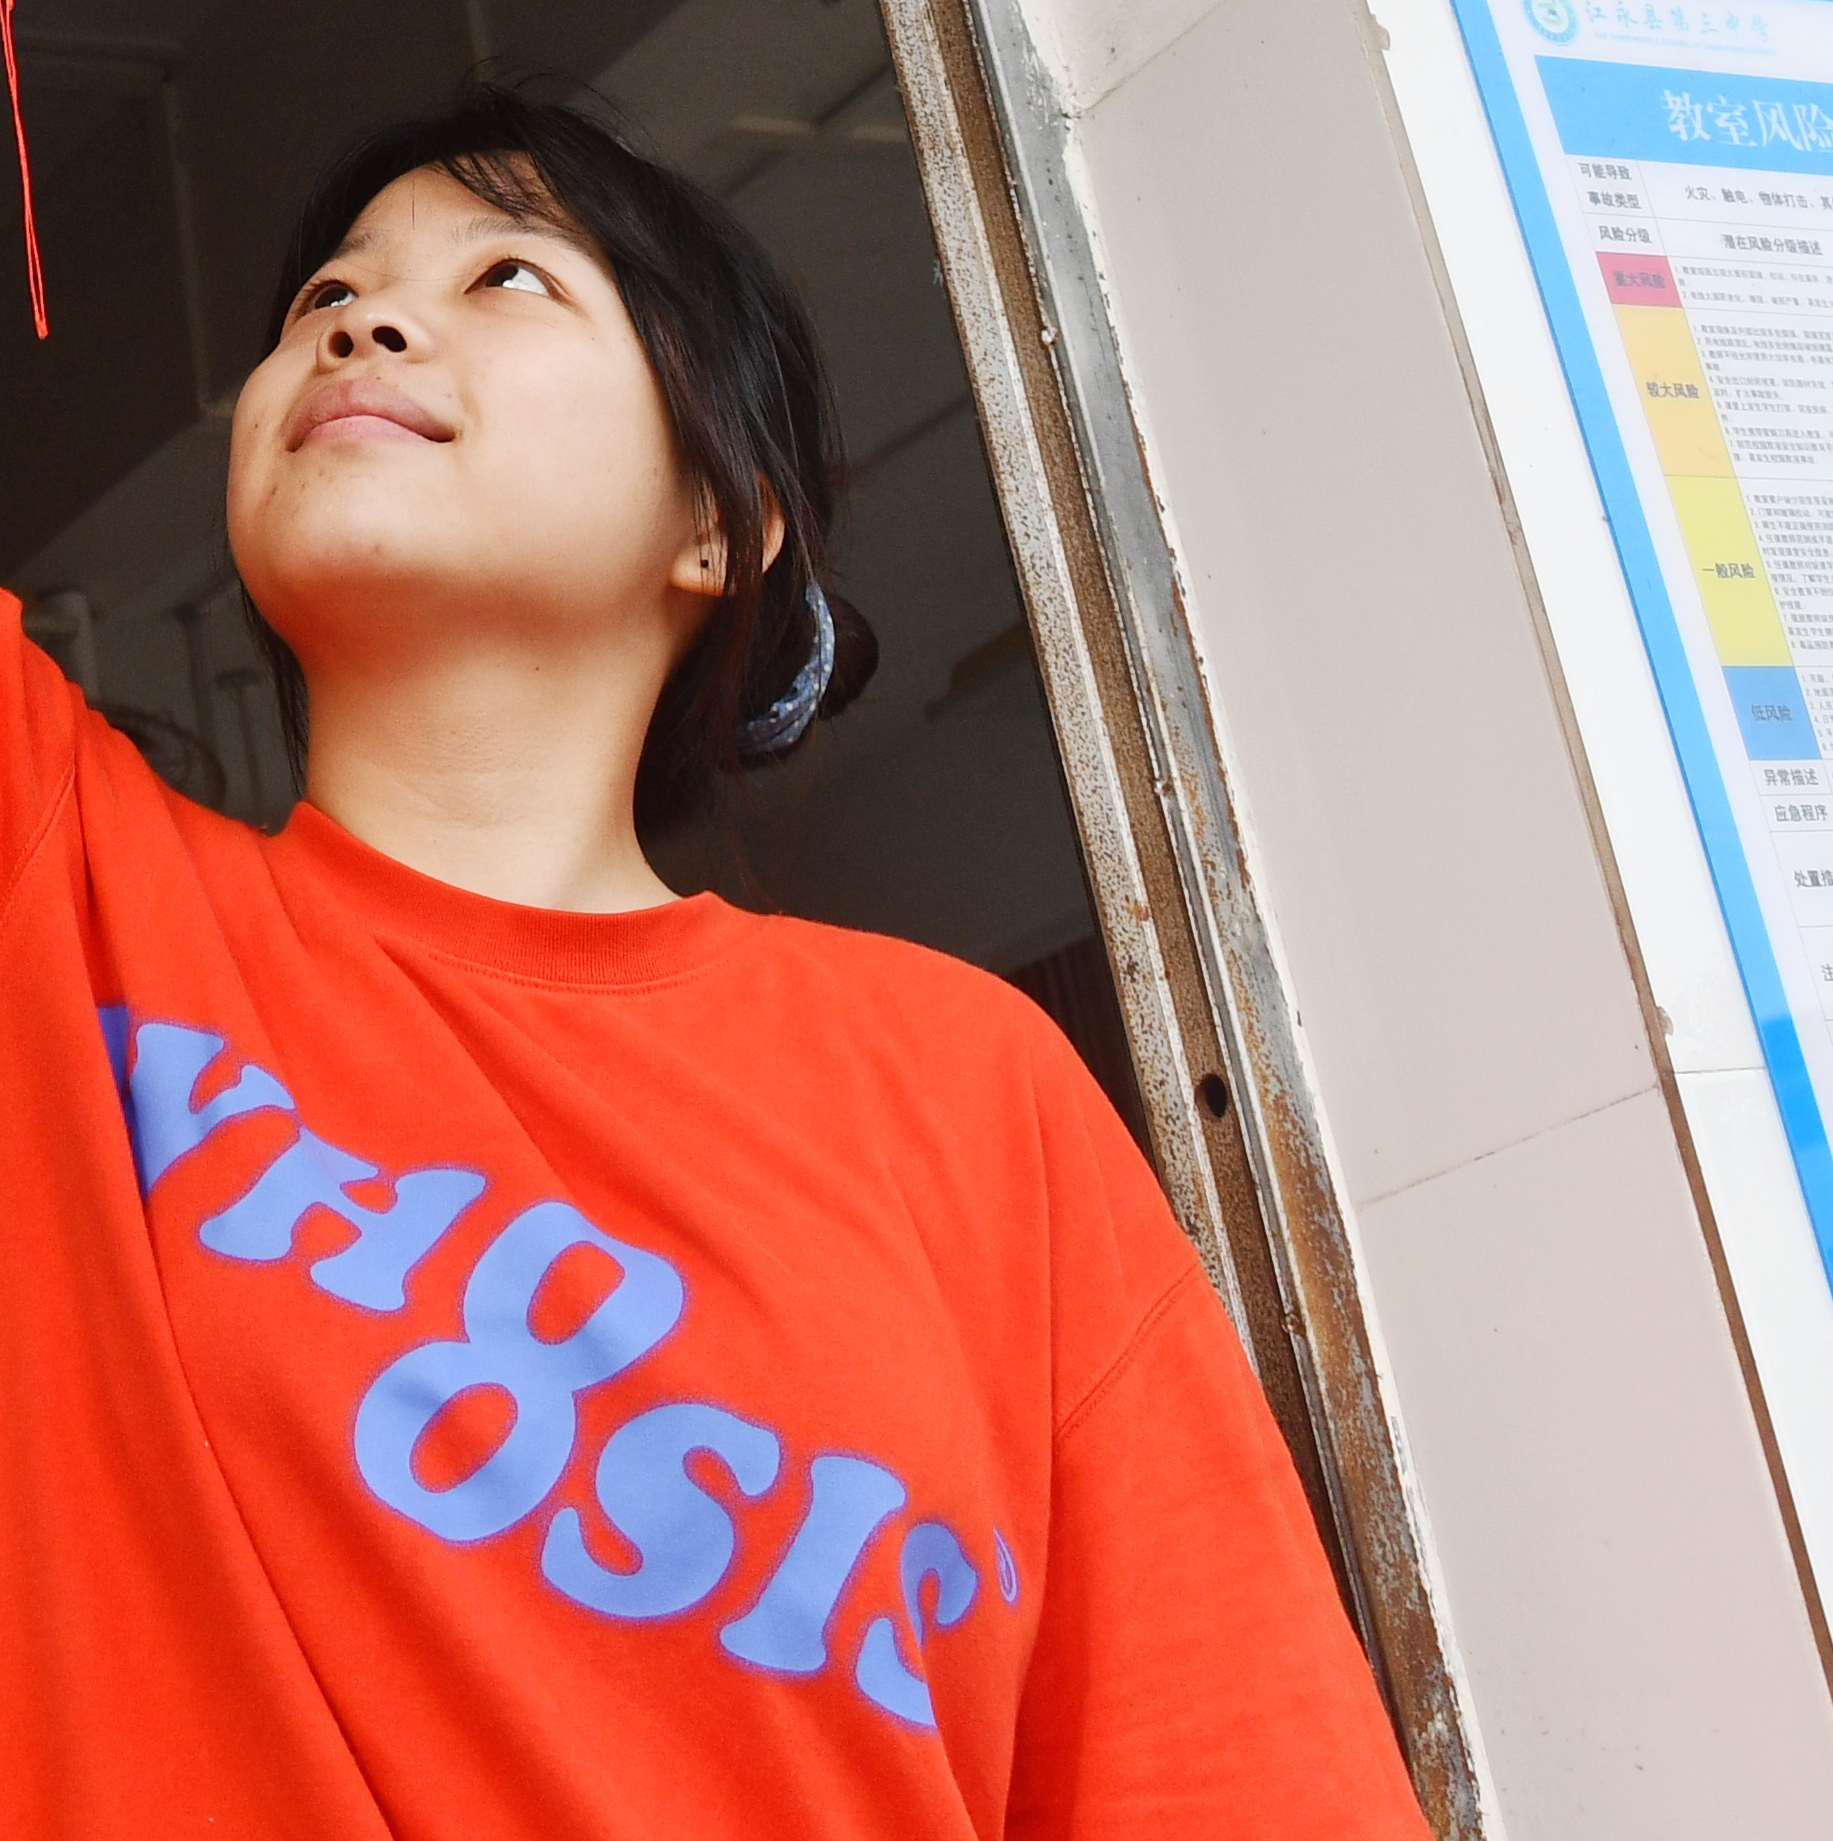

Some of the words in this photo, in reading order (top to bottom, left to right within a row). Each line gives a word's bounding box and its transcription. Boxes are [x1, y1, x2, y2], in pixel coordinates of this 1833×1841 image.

[1577, 162, 1633, 181] 可能导致
[1587, 190, 1642, 209] 事故类型
[1599, 225, 1653, 243] 风险分级
[1721, 233, 1824, 256] 潜在风险分级描述
[1646, 381, 1700, 399] 较大风险
[1702, 563, 1755, 579] 一般风险
[1763, 768, 1819, 786] 异常描述
[1774, 804, 1828, 822] 应急程序
